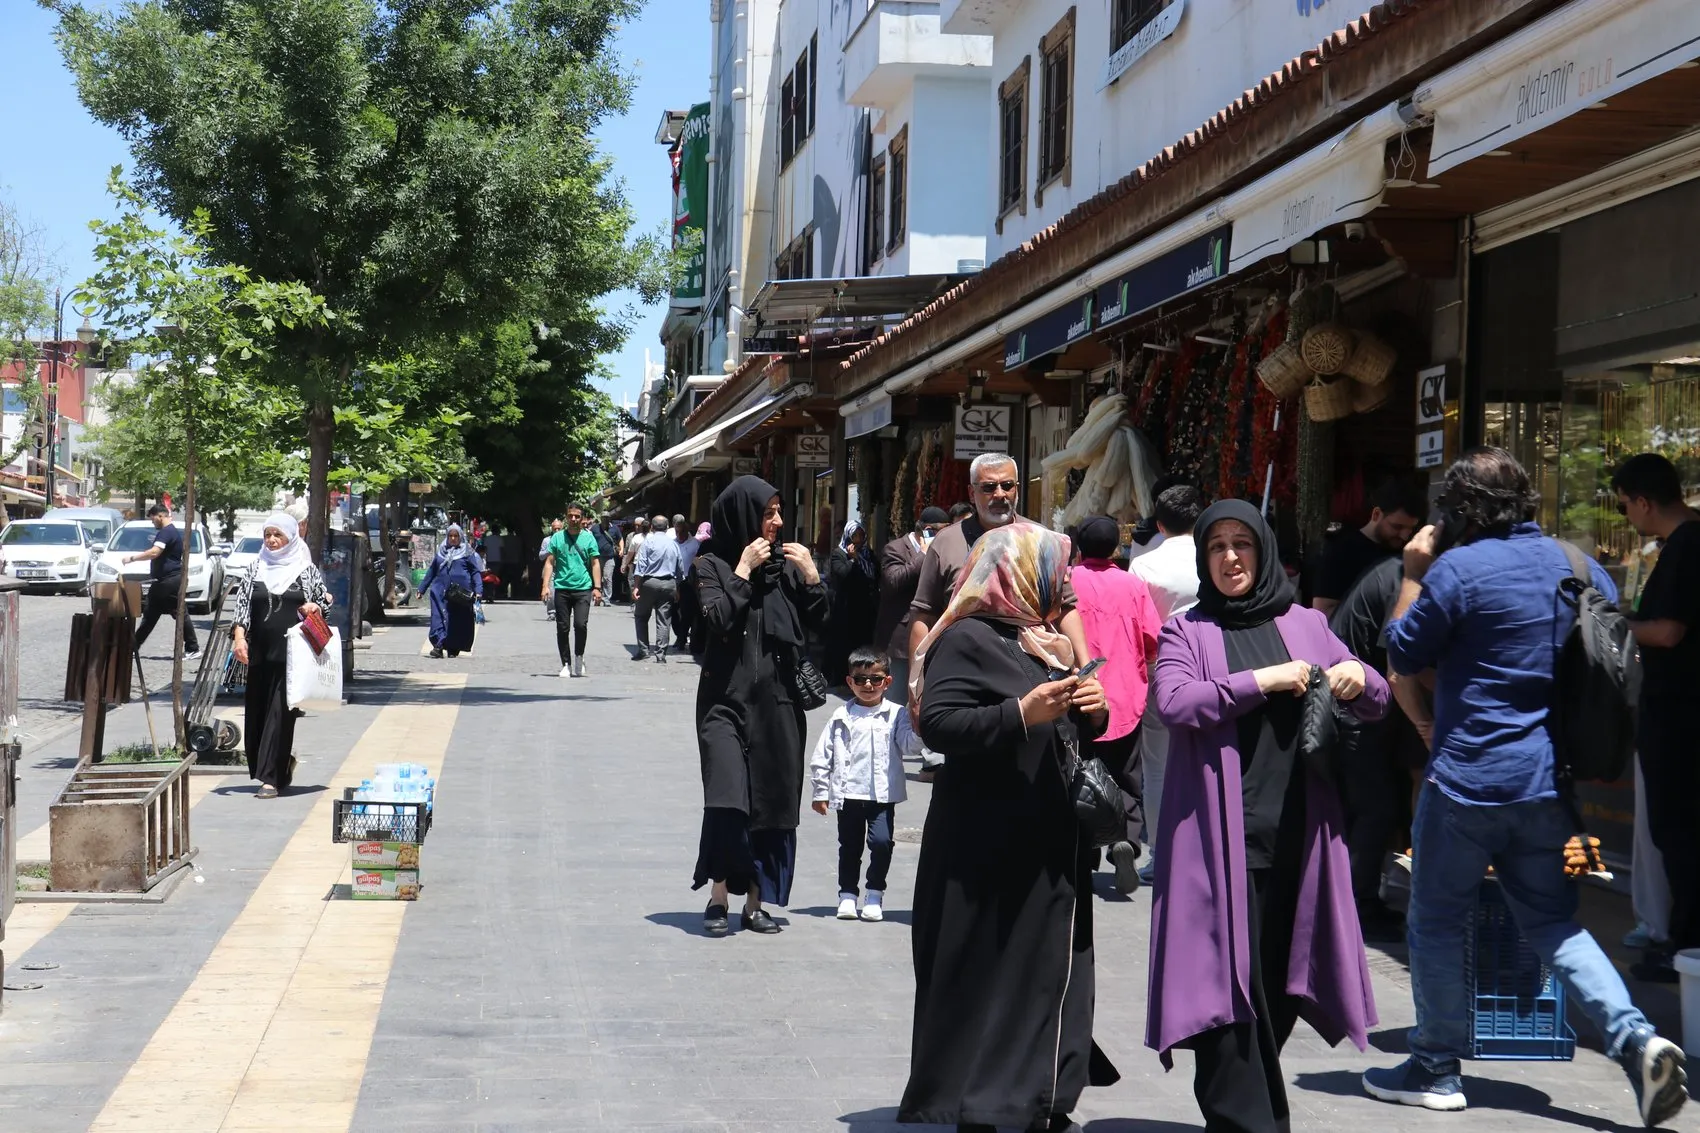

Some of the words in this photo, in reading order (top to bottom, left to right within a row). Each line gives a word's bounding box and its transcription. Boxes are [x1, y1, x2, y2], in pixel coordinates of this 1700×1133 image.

[1516, 61, 1574, 125] akdemir
[1578, 58, 1613, 96] GOLD
[1187, 263, 1213, 287] akdemir
[1101, 302, 1121, 322] akdemir
